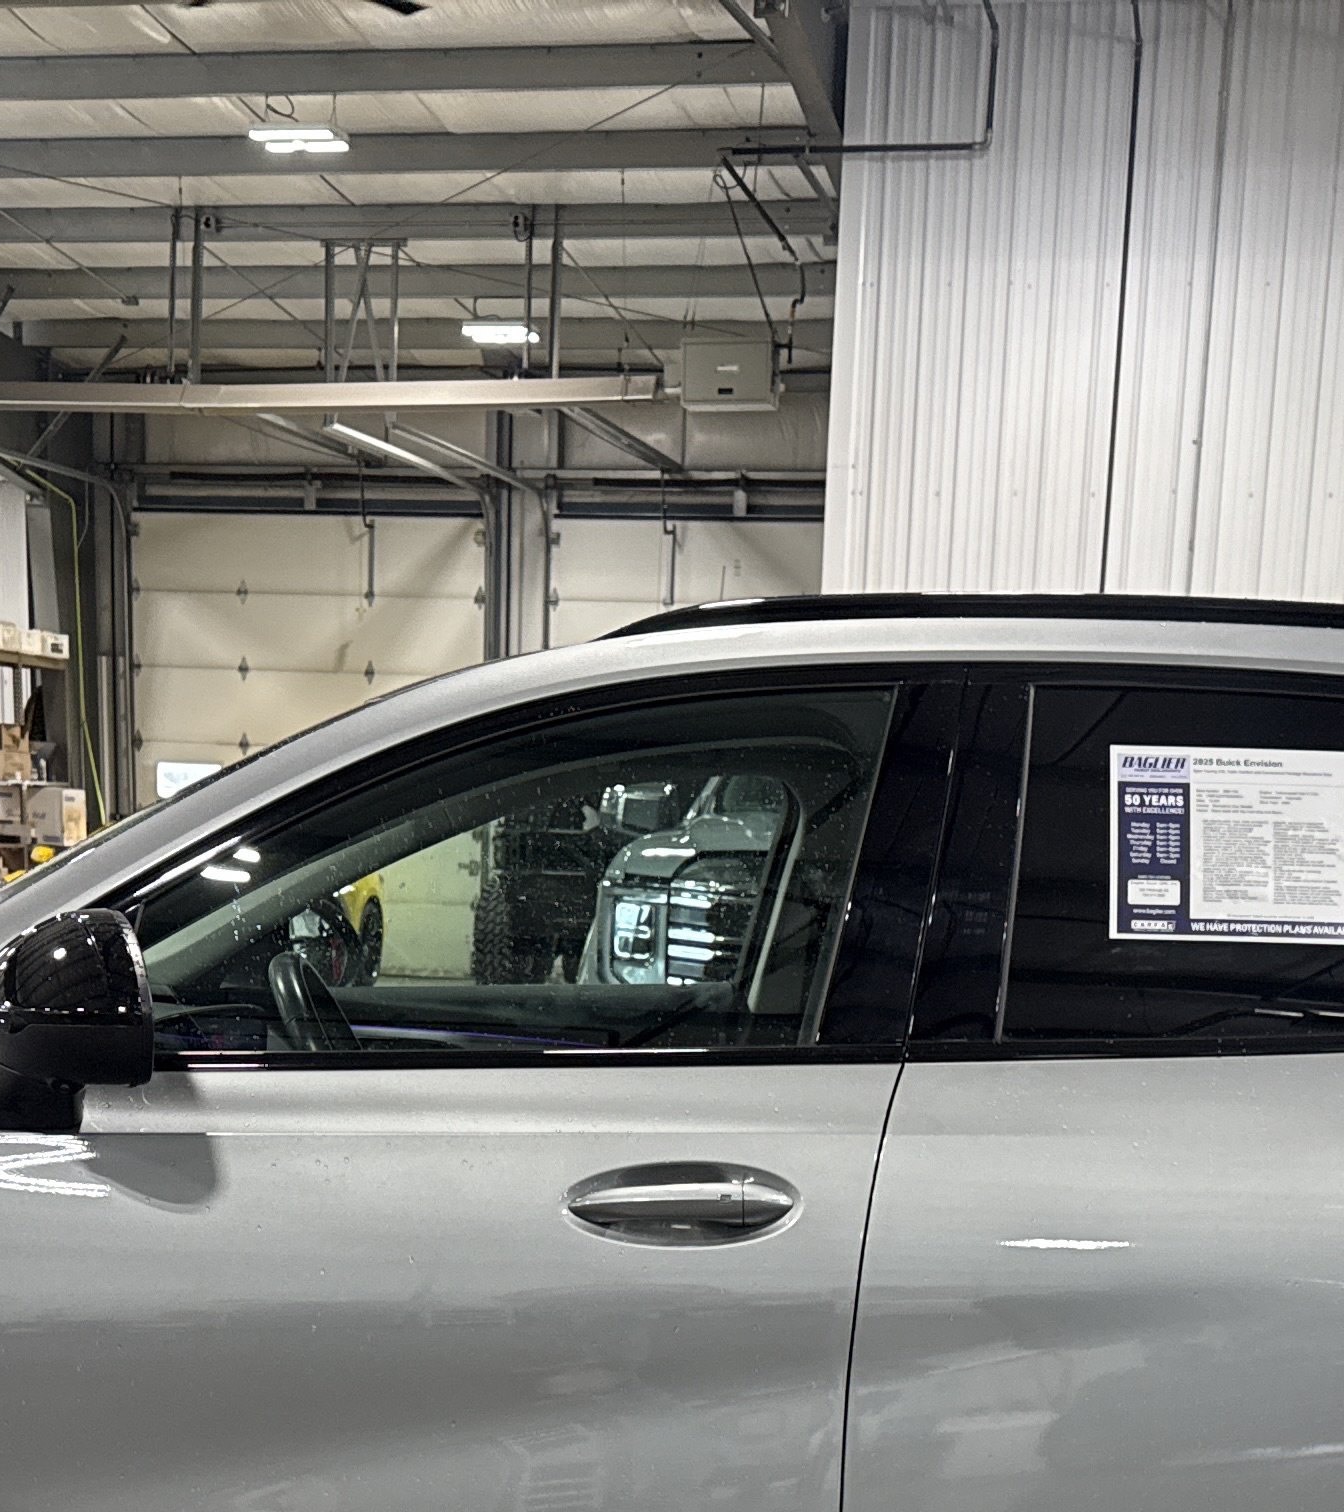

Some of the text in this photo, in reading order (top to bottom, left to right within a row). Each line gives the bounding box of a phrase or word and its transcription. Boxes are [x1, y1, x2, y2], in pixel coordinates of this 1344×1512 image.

[1122, 756, 1186, 769] BAGLIER
[1193, 758, 1283, 768] 2025 Buick Envision
[1125, 794, 1141, 806] 50
[1143, 795, 1184, 807] YEARS
[1191, 922, 1205, 932] WE
[1206, 922, 1229, 932] HAVE
[1229, 923, 1282, 933] PROTECTION
[1283, 924, 1312, 935] PLANS
